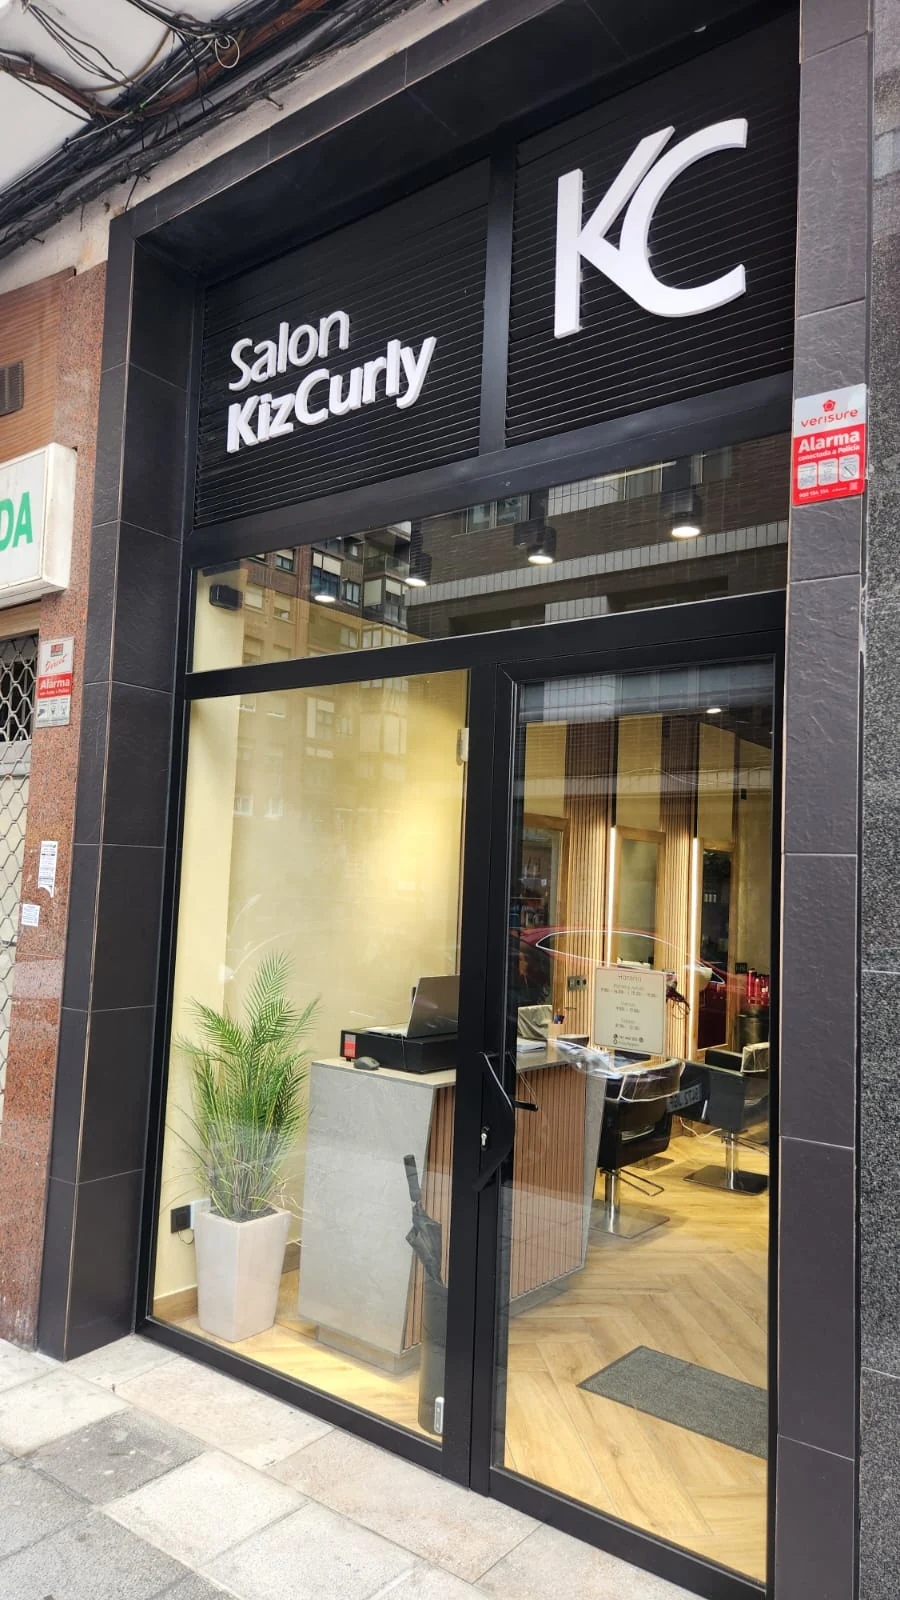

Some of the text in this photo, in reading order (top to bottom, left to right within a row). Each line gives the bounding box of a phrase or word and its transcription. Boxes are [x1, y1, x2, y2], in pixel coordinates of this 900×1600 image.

[554, 118, 748, 340] KC
[228, 310, 350, 391] Salon
[226, 336, 438, 454] KizCurly
[800, 408, 859, 428] verisure
[798, 430, 860, 454] Alarma
[40, 677, 71, 690] Alarma
